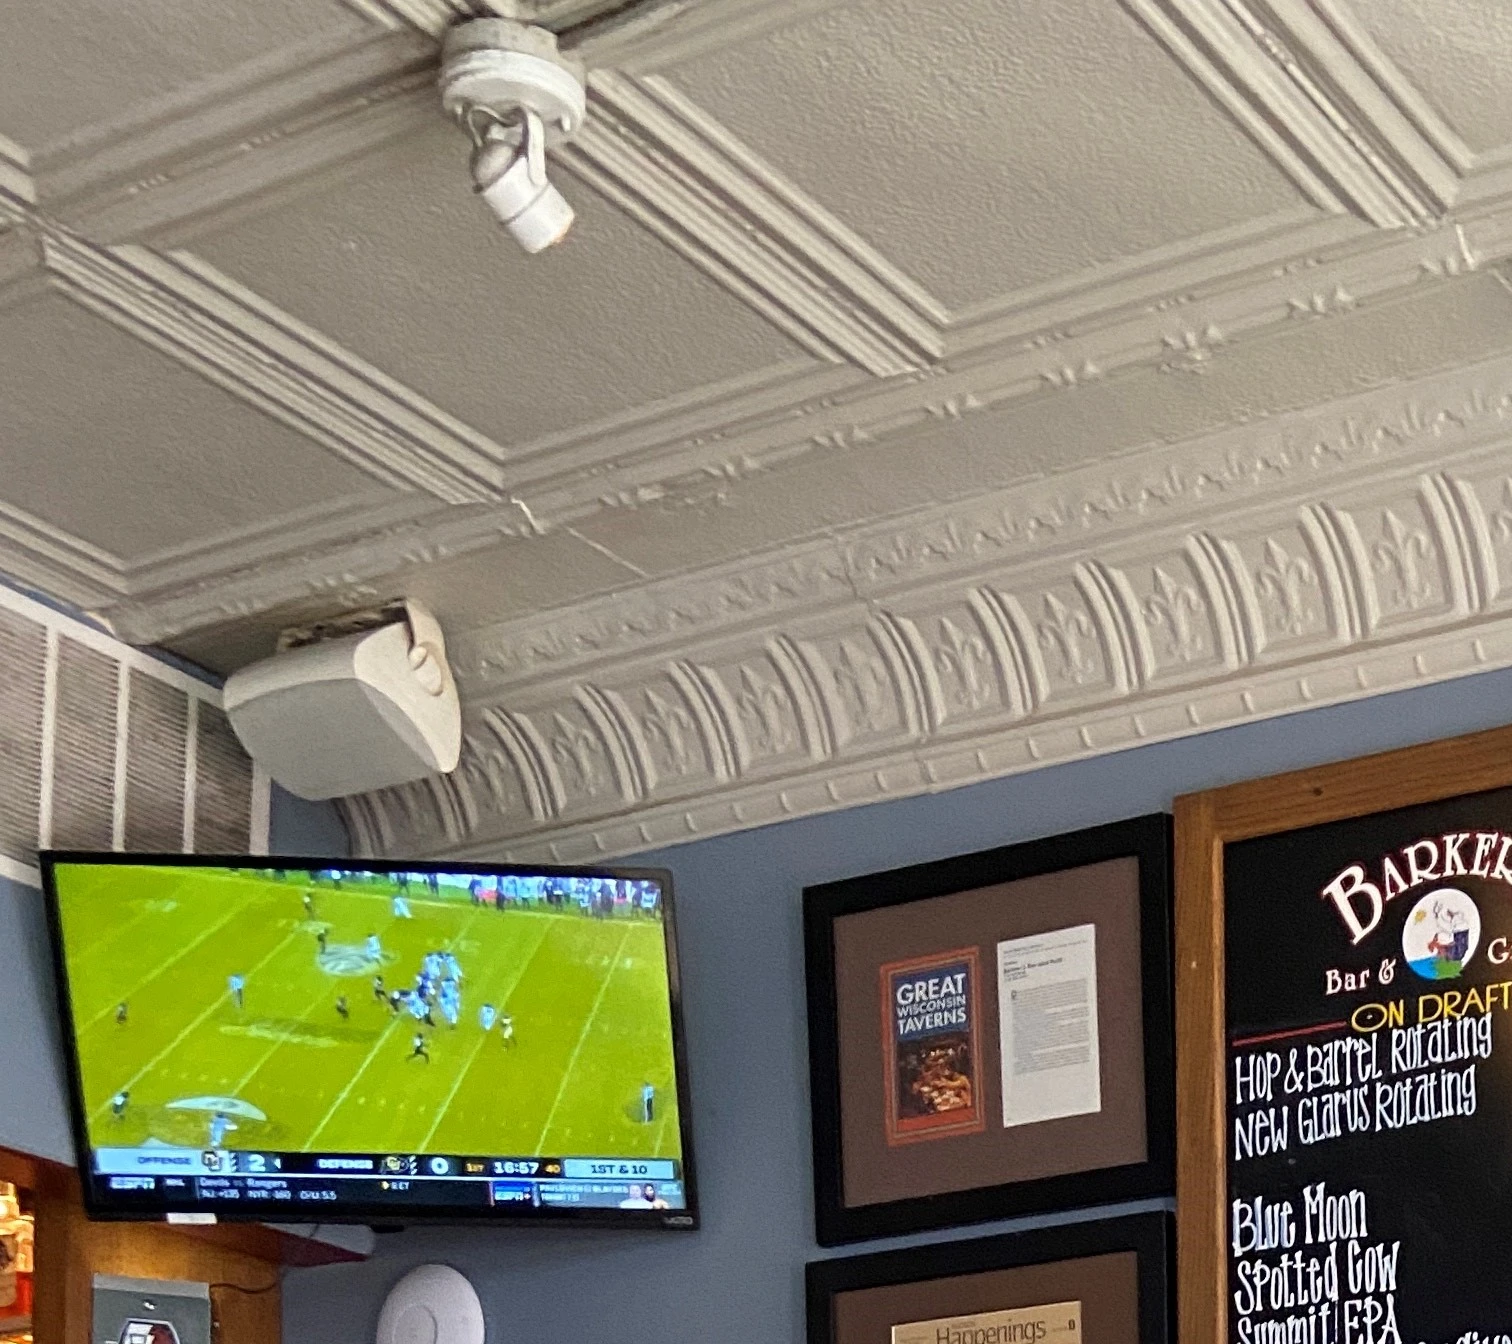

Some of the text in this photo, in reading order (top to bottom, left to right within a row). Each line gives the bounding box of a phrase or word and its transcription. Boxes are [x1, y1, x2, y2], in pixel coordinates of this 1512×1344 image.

[896, 973, 966, 1005] GREAT
[1325, 960, 1370, 995] Bar
[1378, 960, 1395, 985] &
[897, 994, 966, 1018] WISCONSIN
[898, 1007, 966, 1035] TAVERNS
[1351, 982, 1512, 1033] ON DRAFT
[1284, 1049, 1304, 1092] &
[1391, 1012, 1493, 1069] Rotating
[1234, 1065, 1477, 1161] New Glarus Rotating
[137, 1156, 191, 1165] OFFENSE
[591, 1164, 648, 1175] 1ST & 10
[1232, 1182, 1368, 1257] Blue Moon
[1234, 1239, 1400, 1315] Spotted Cow
